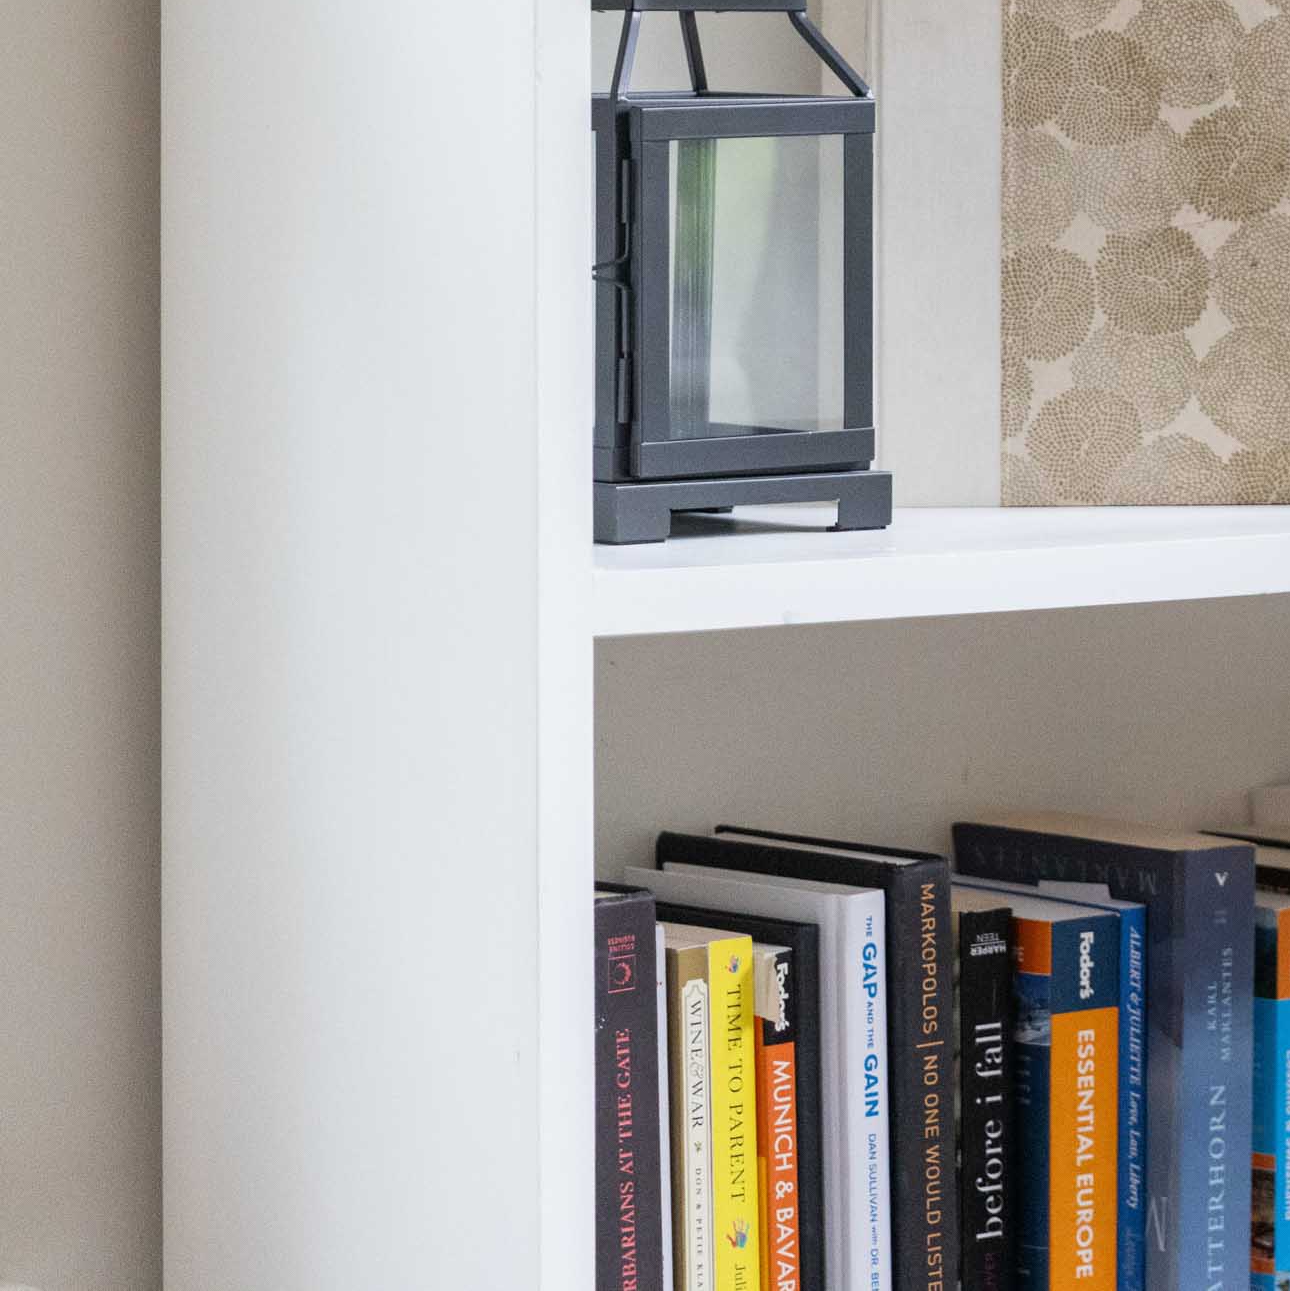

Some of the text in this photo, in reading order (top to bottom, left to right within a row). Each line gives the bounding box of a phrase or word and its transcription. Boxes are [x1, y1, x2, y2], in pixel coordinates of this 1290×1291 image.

[921, 883, 938, 1035] MARKOPOLOS
[970, 942, 1006, 956] HARPER
[976, 932, 1000, 942] TEEN
[1079, 931, 1095, 1000] Fodor's
[1129, 926, 1142, 994] ALBERT
[774, 962, 790, 1032] Fodor's
[863, 942, 878, 999] GAP
[1208, 983, 1217, 1030] KARL
[1221, 947, 1232, 1060] MARLANTES
[616, 1028, 633, 1090] GATE
[924, 1055, 939, 1086] NO
[1127, 1003, 1142, 1086] JULIETTE
[727, 984, 745, 1202] TIME TO PARENT
[772, 1060, 793, 1171] MUNICH
[864, 1054, 879, 1118] GAIN
[924, 1093, 940, 1139] ONE
[618, 1093, 634, 1143] THE
[868, 1133, 877, 1160] DAN
[975, 1021, 1004, 1240] before i fall
[619, 1148, 634, 1174] AT
[926, 1144, 942, 1225] WOULD
[1075, 1028, 1095, 1279] ESSENTIAL EUROPE
[775, 1181, 794, 1200] &
[869, 1164, 878, 1222] SULLIVAN
[1126, 1163, 1140, 1209] Liberty
